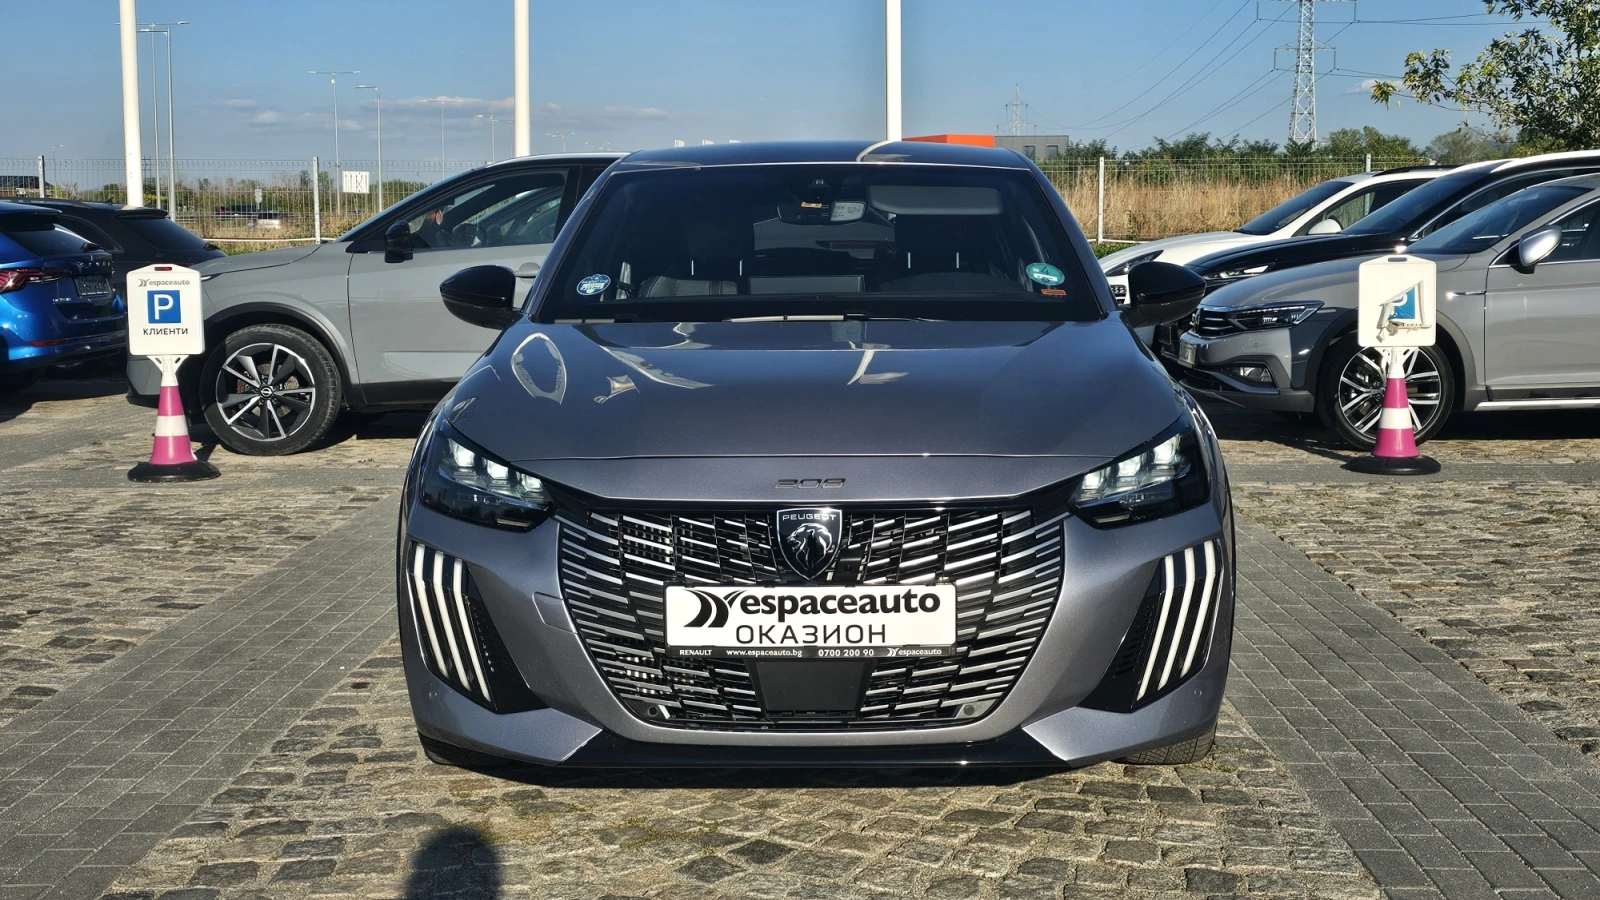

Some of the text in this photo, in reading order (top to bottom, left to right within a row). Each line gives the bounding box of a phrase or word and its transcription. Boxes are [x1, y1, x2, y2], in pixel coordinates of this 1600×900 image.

[148, 279, 190, 287] espaceauto
[153, 293, 174, 320] P
[142, 327, 189, 336] КЛИЕНТИ
[774, 478, 847, 489] 208
[782, 513, 837, 521] PEUGEOT
[740, 588, 941, 623] espaceauto
[735, 624, 886, 645] ОКАЗИОН
[726, 648, 803, 658] www.espaceauto.bg
[817, 648, 841, 657] 0700
[843, 648, 861, 657] 200
[862, 648, 875, 657] 90
[897, 648, 943, 656] espaceauto
